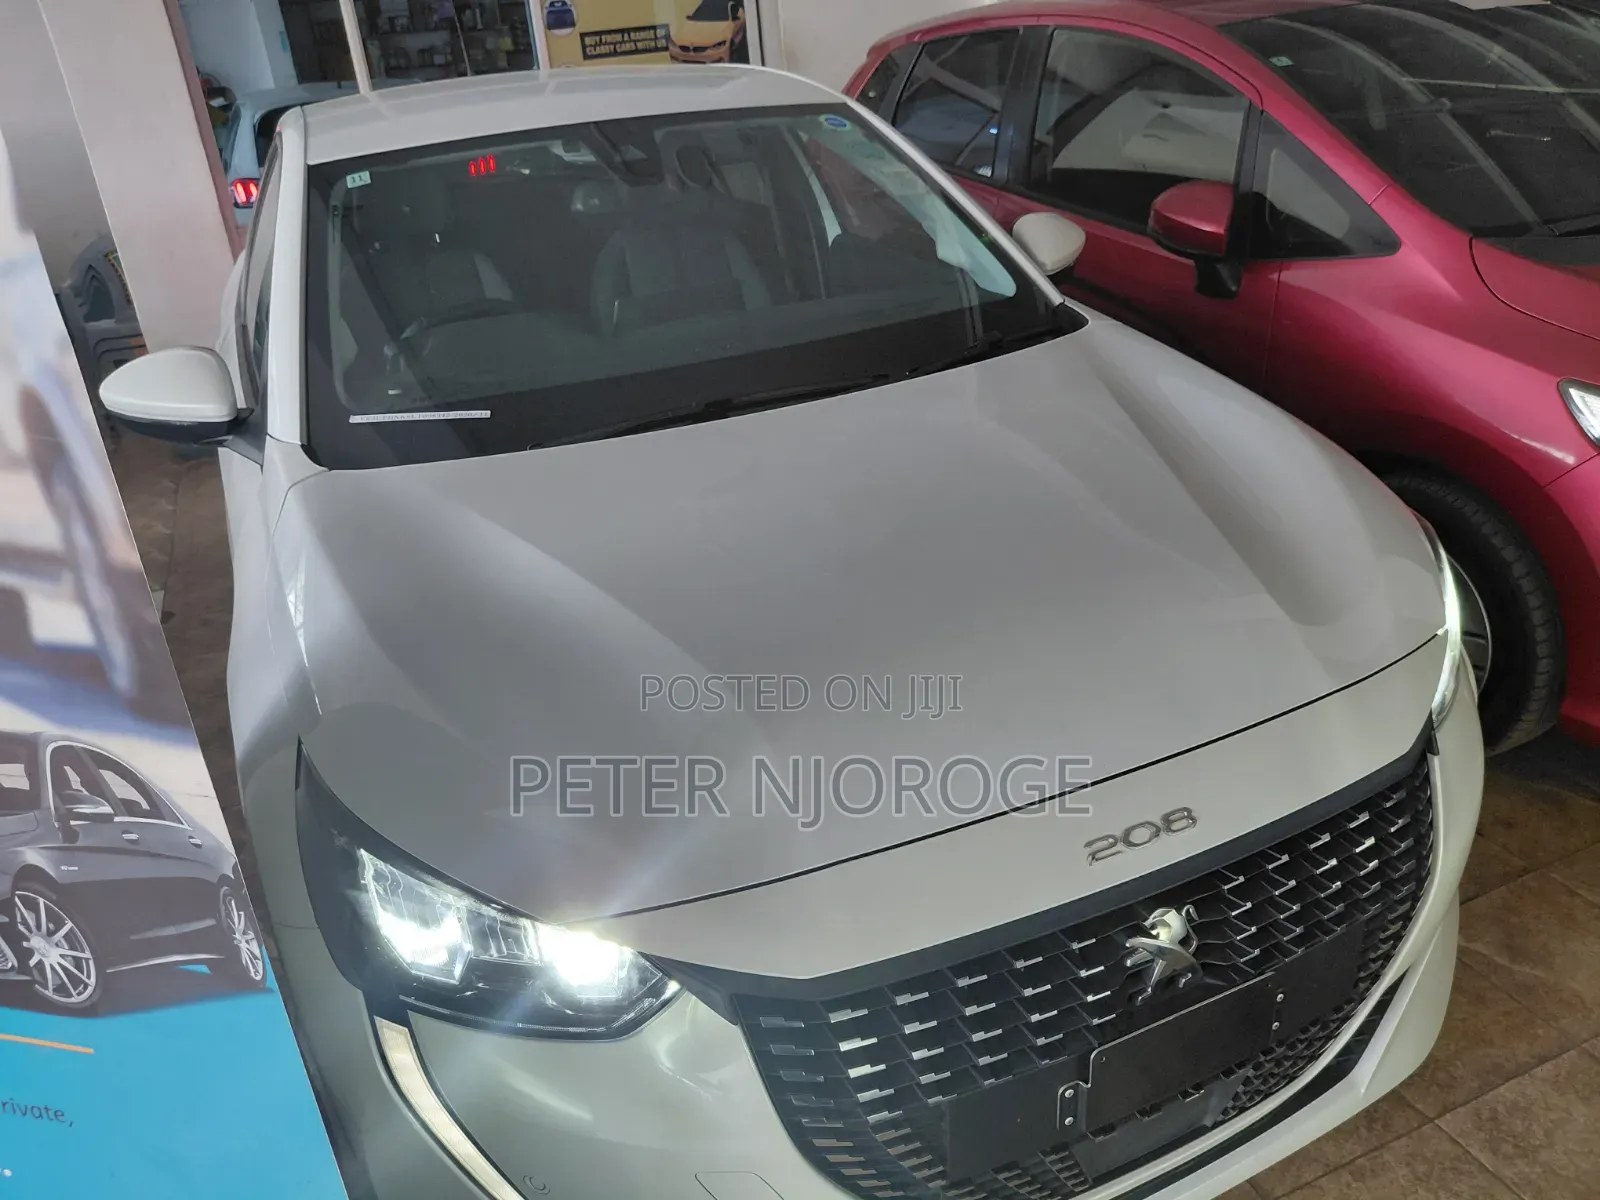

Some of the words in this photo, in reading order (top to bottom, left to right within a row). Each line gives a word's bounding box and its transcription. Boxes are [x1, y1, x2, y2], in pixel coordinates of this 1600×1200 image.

[584, 35, 600, 45] BUY
[601, 33, 622, 43] FROM
[623, 32, 630, 41] A
[630, 30, 655, 40] RANGE
[585, 44, 615, 56] CLASSY
[615, 42, 636, 52] CARS
[636, 40, 656, 50] WITH
[656, 38, 667, 48] US
[1083, 806, 1198, 866] 208
